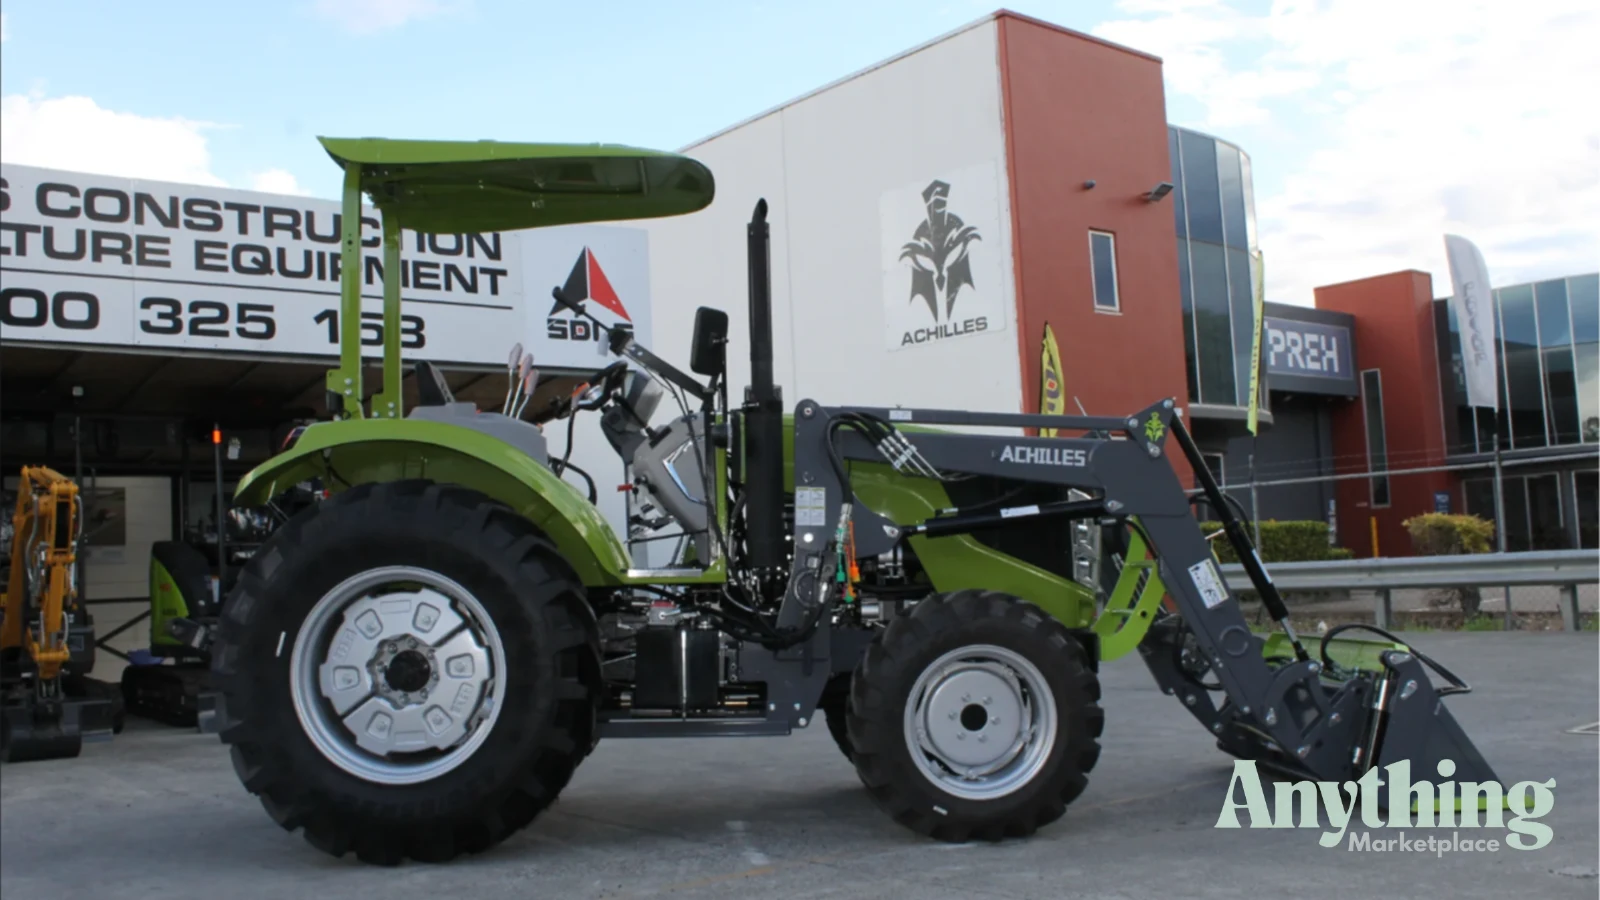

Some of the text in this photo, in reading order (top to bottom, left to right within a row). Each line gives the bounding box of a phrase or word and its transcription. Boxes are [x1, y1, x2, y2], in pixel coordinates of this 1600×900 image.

[35, 182, 503, 261] CONSTRUCION
[139, 296, 276, 340] 325
[901, 316, 988, 346] ACHILLES
[1000, 445, 1086, 467] ACHILLES
